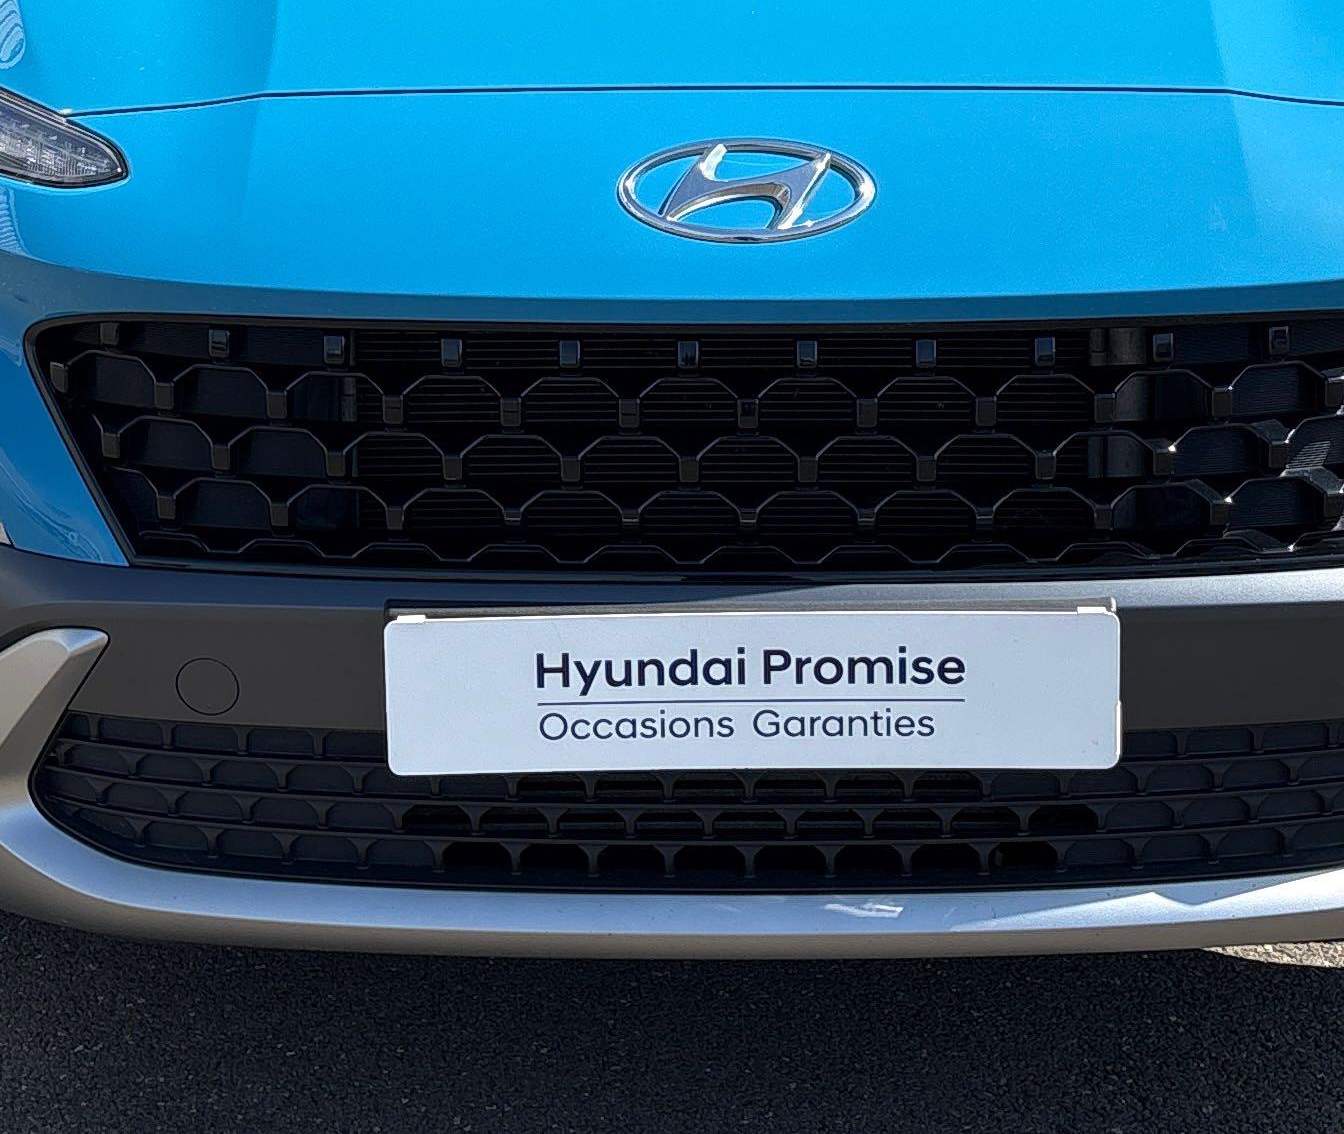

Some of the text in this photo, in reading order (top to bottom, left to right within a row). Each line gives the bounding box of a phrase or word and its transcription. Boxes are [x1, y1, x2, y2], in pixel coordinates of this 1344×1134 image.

[536, 645, 966, 696] Hyundai Promise
[539, 707, 936, 741] Occasions Garanties
